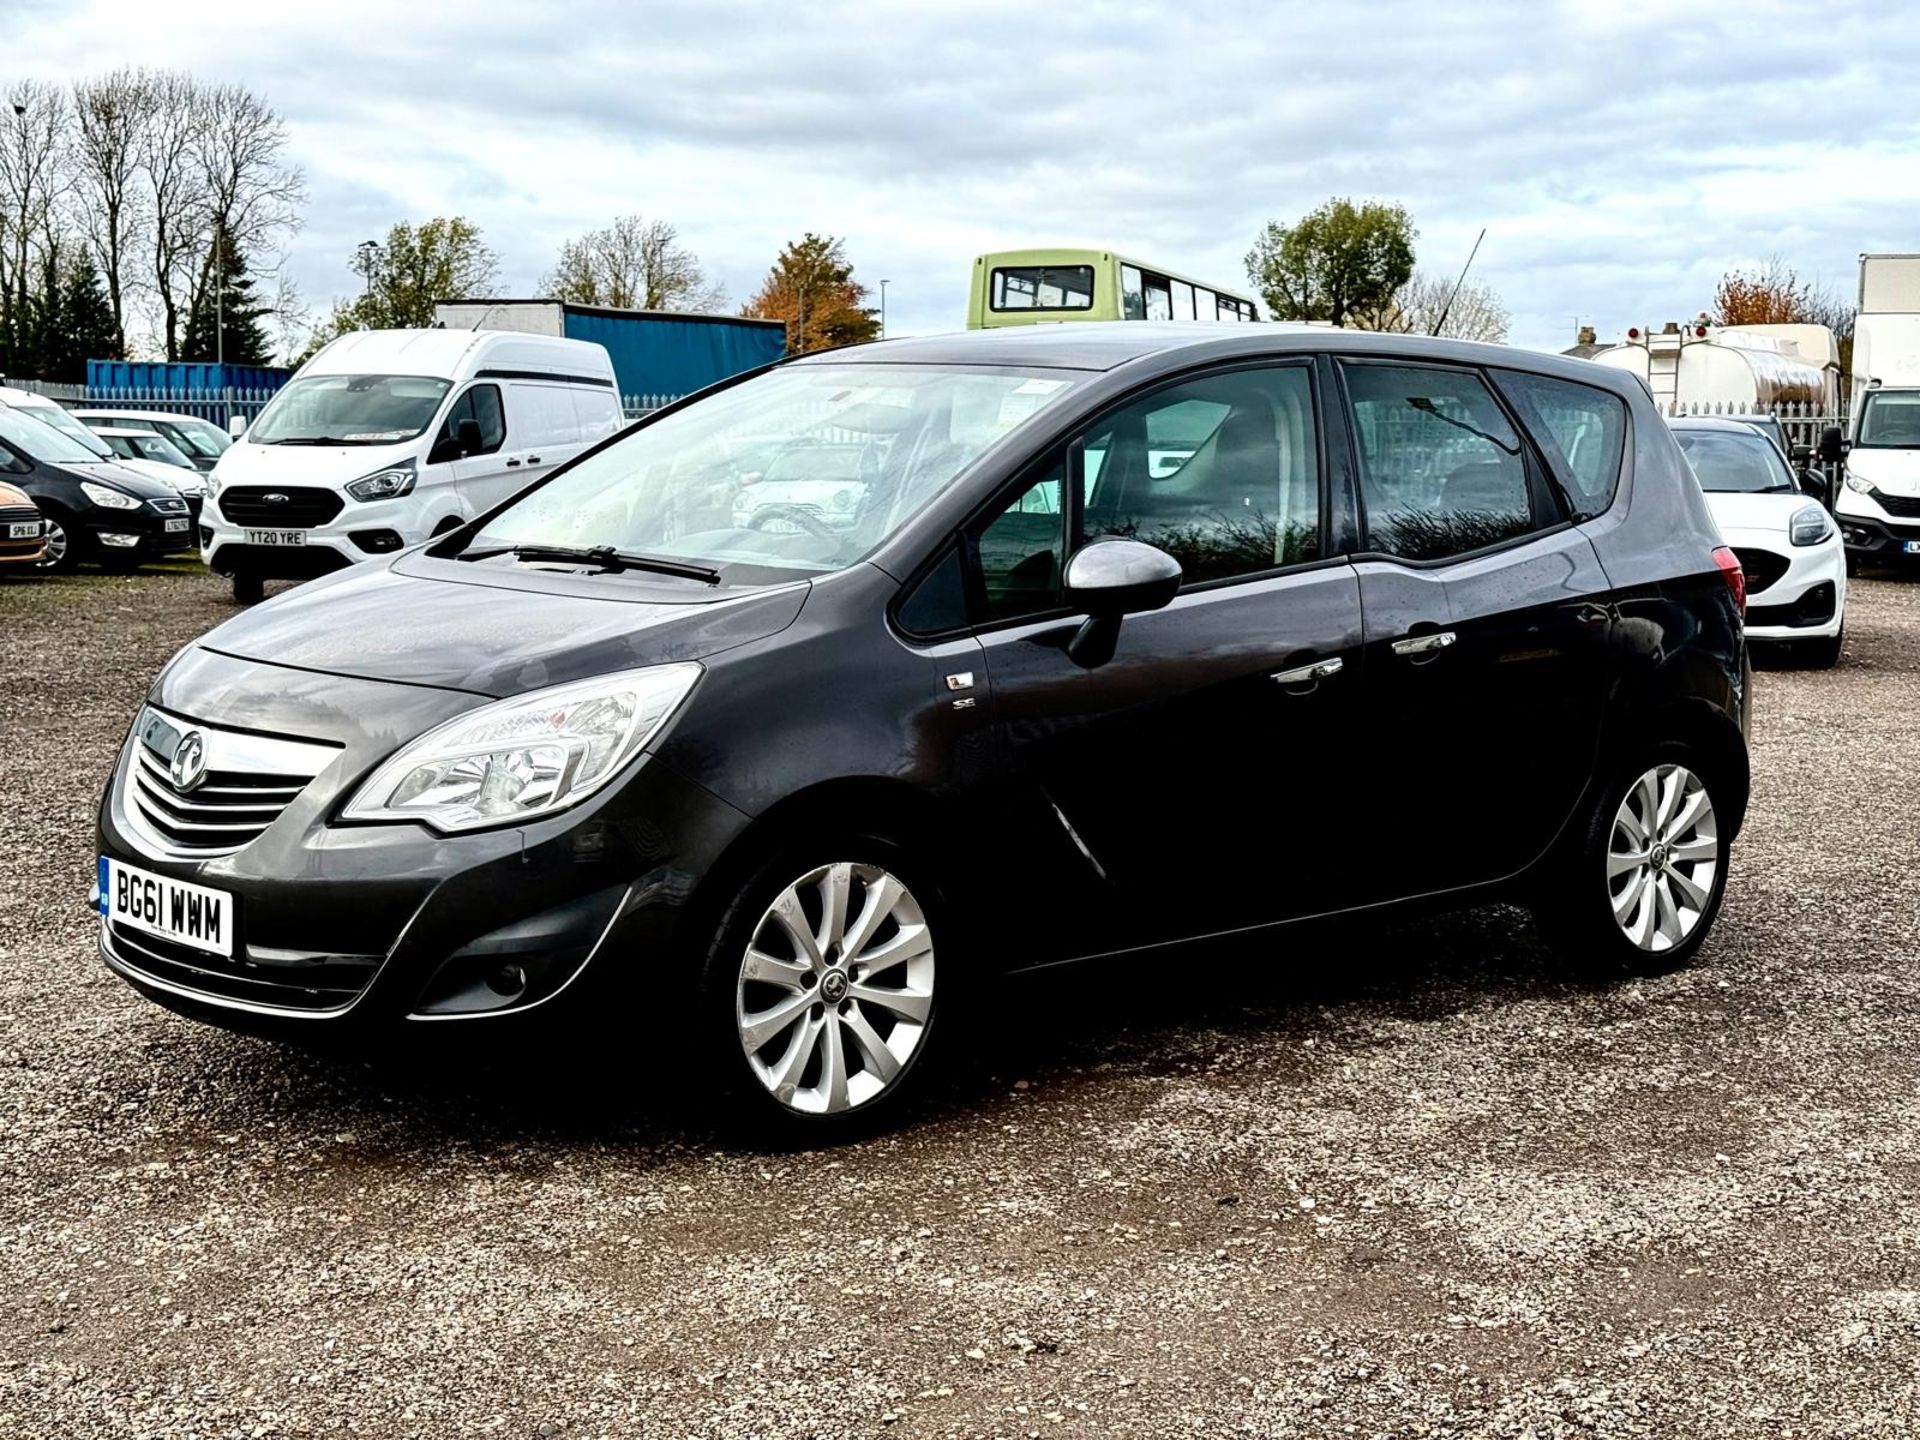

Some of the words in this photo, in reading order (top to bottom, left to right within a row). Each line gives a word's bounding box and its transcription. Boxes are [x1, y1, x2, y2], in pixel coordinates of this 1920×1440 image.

[250, 531, 277, 544] YT20
[280, 533, 302, 544] YRE
[117, 868, 162, 927] BG61
[170, 886, 220, 944] WWM
